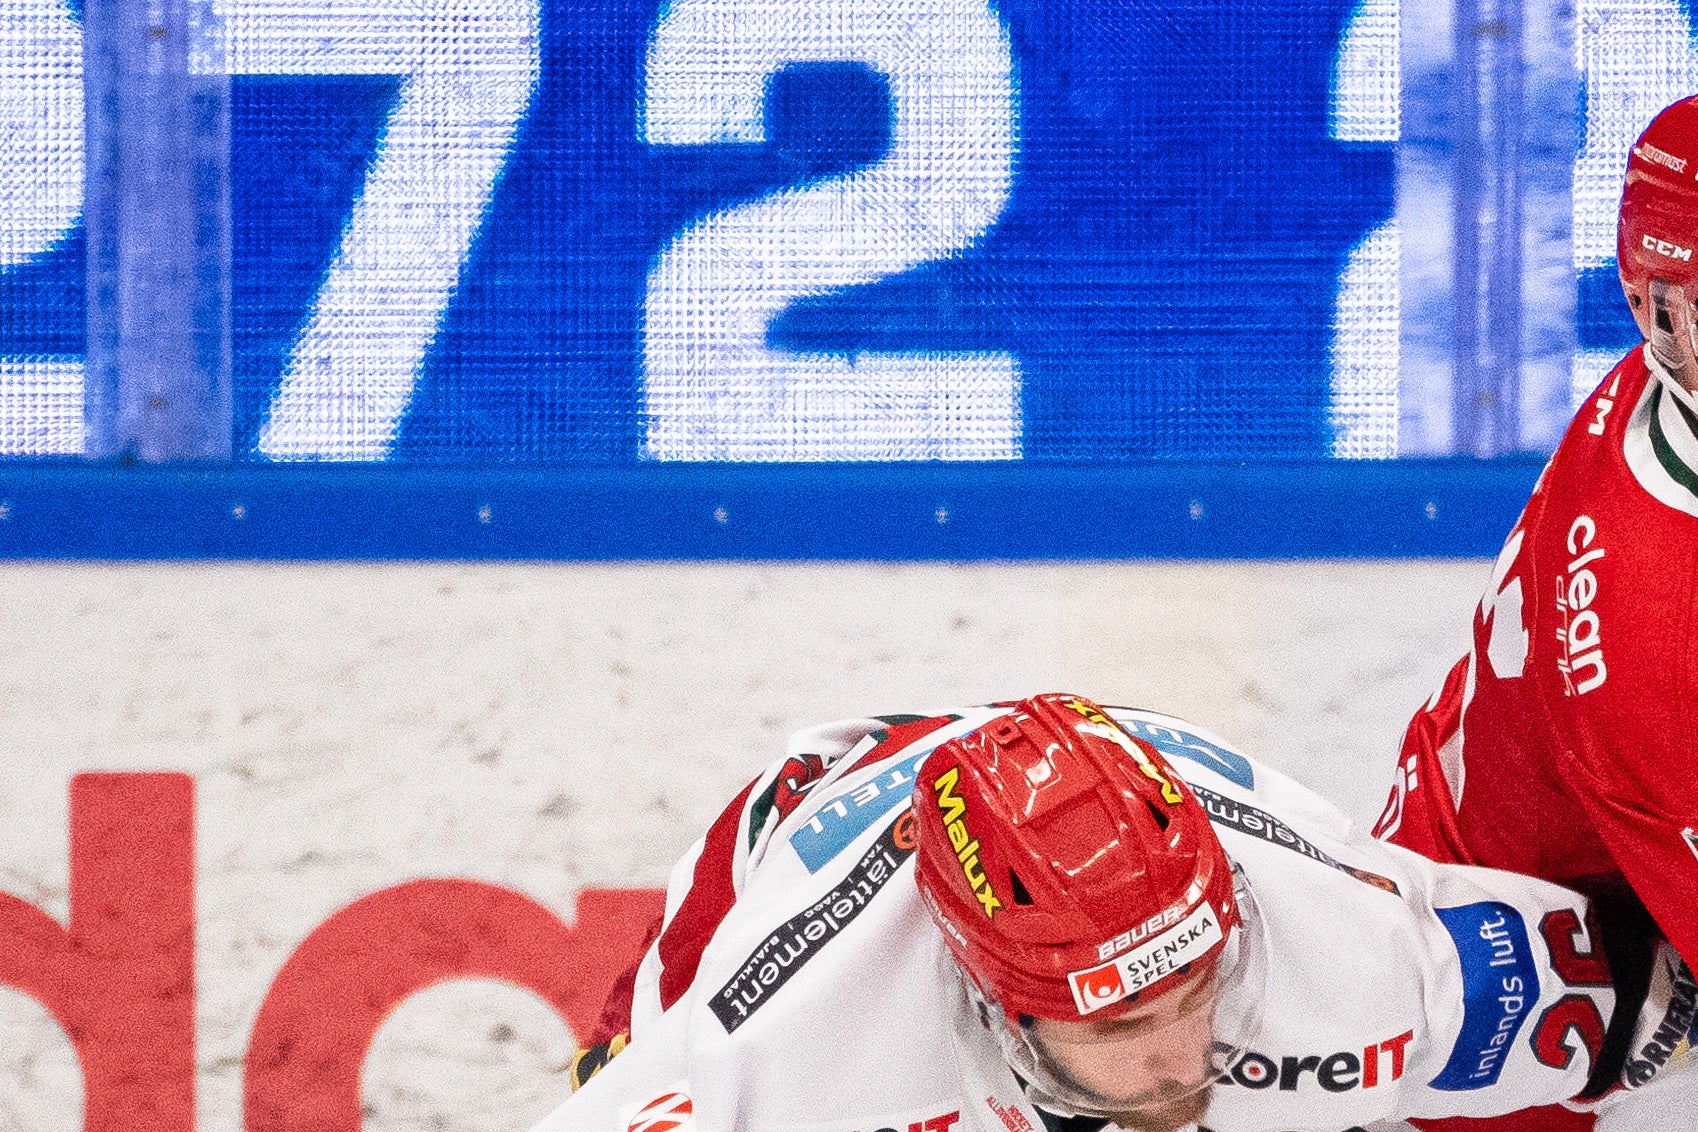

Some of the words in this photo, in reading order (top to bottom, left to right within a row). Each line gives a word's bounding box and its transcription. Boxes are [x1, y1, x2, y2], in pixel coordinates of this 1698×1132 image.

[0, 0, 1023, 461] 72
[1641, 233, 1694, 262] CCM
[1566, 513, 1608, 697] clean
[797, 752, 930, 836] TELL
[934, 766, 1002, 919] Malux
[729, 849, 898, 1018] lättelement
[1126, 916, 1213, 977] SVENSKA
[1132, 958, 1179, 989] SPEL
[1468, 975, 1525, 1080] inlands
